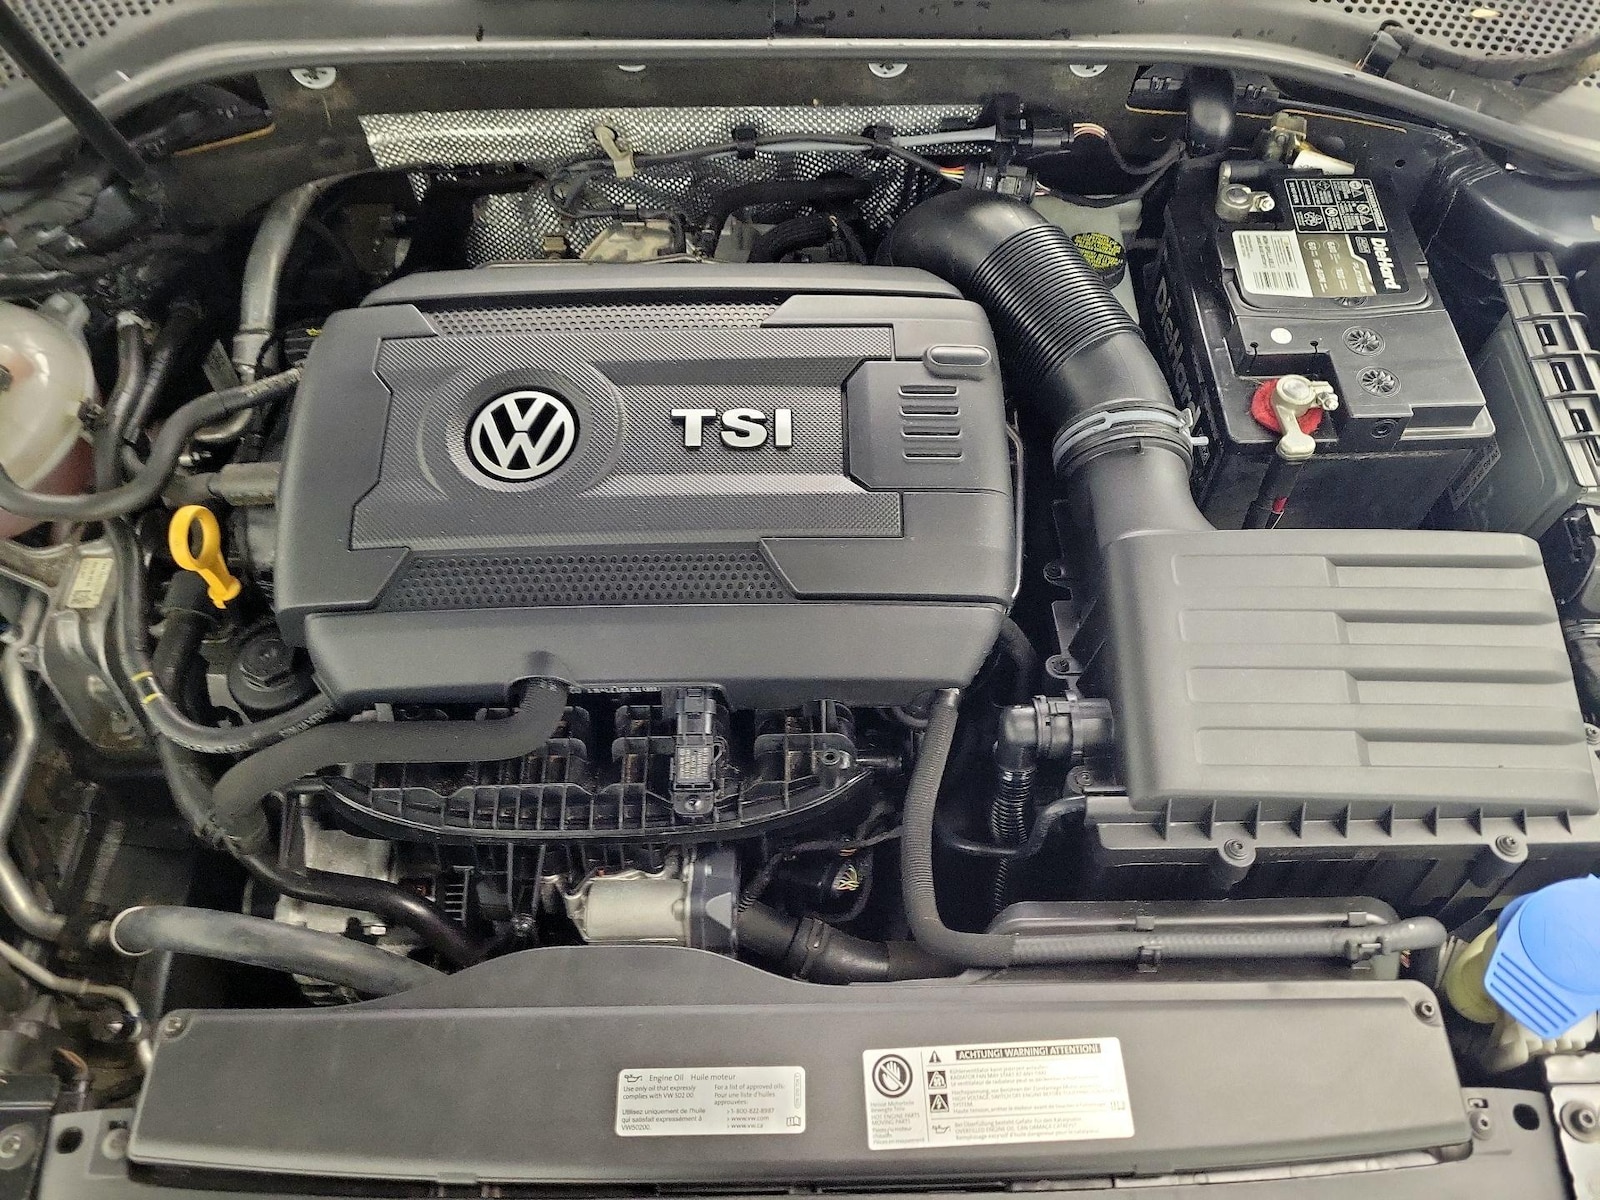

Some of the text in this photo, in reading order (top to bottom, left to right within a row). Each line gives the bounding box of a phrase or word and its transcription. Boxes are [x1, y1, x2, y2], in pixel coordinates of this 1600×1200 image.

[1370, 237, 1401, 290] DieHard
[671, 408, 793, 448] TSI
[1050, 1044, 1098, 1056] ATTENTION!
[649, 1074, 672, 1083] Engine
